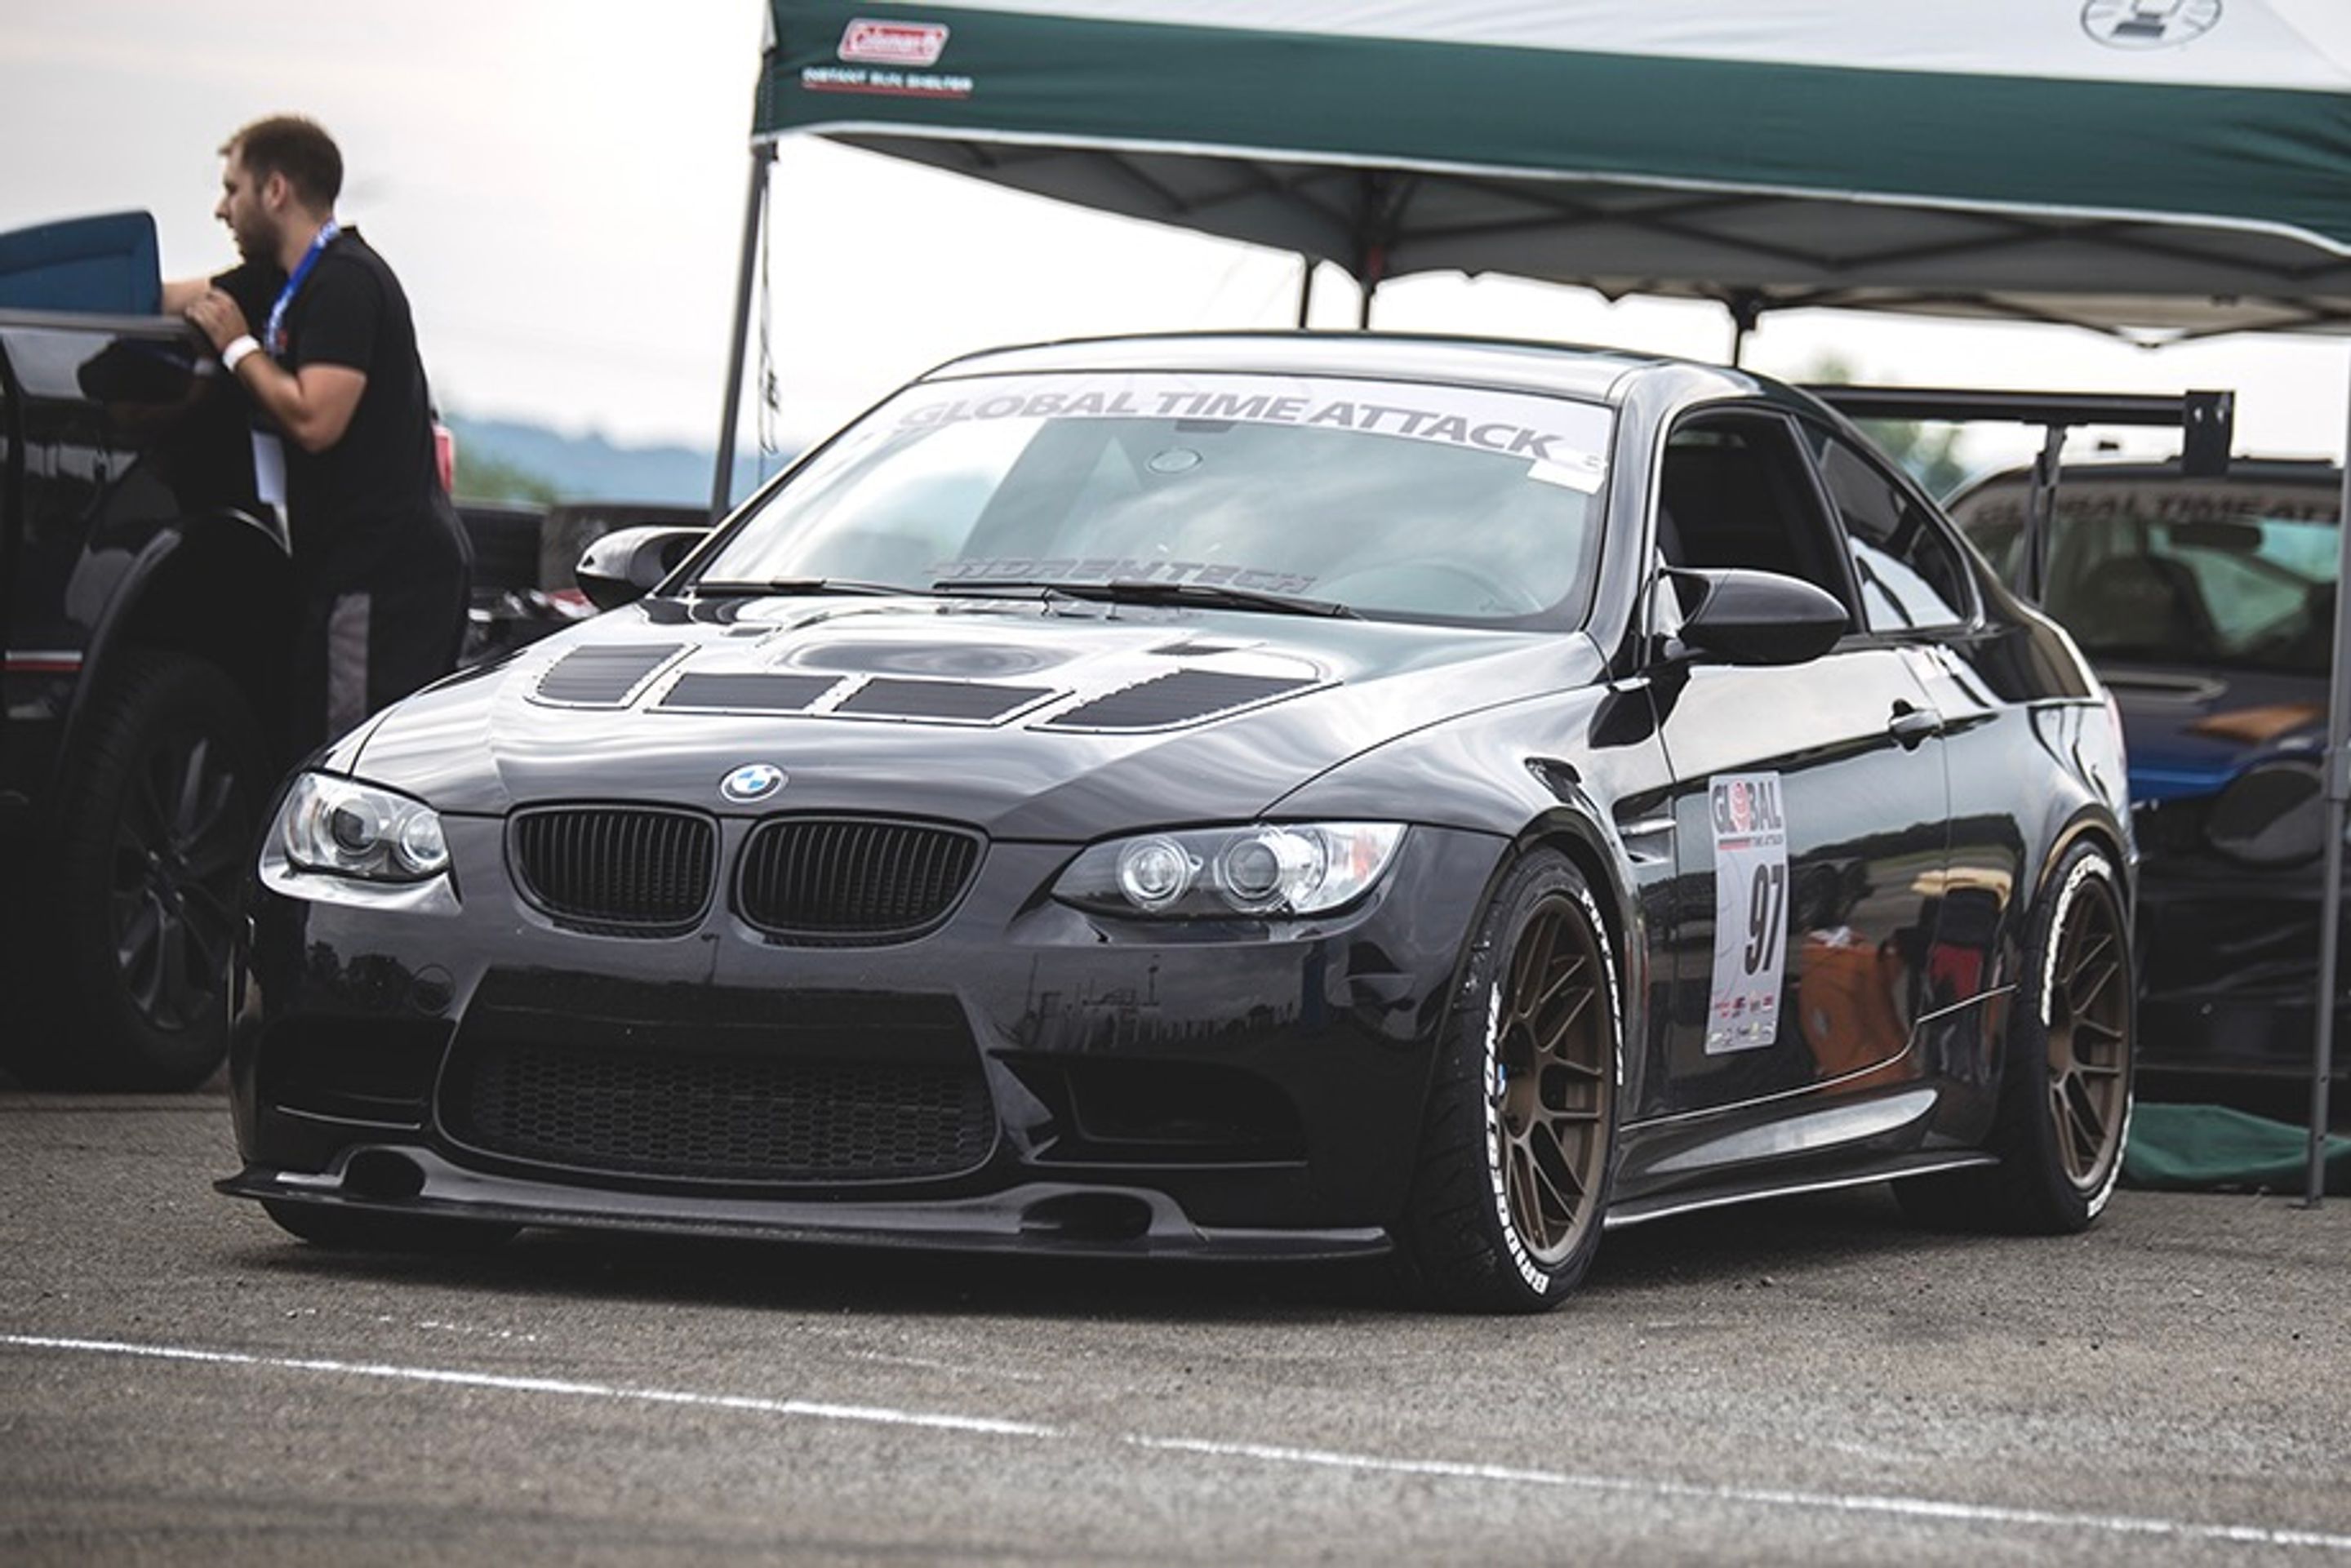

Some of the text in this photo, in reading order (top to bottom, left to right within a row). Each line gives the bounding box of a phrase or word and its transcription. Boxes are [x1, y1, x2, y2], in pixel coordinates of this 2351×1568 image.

[898, 391, 1564, 460] GLOBAL TIME ATTACK
[1744, 864, 1785, 975] 97
